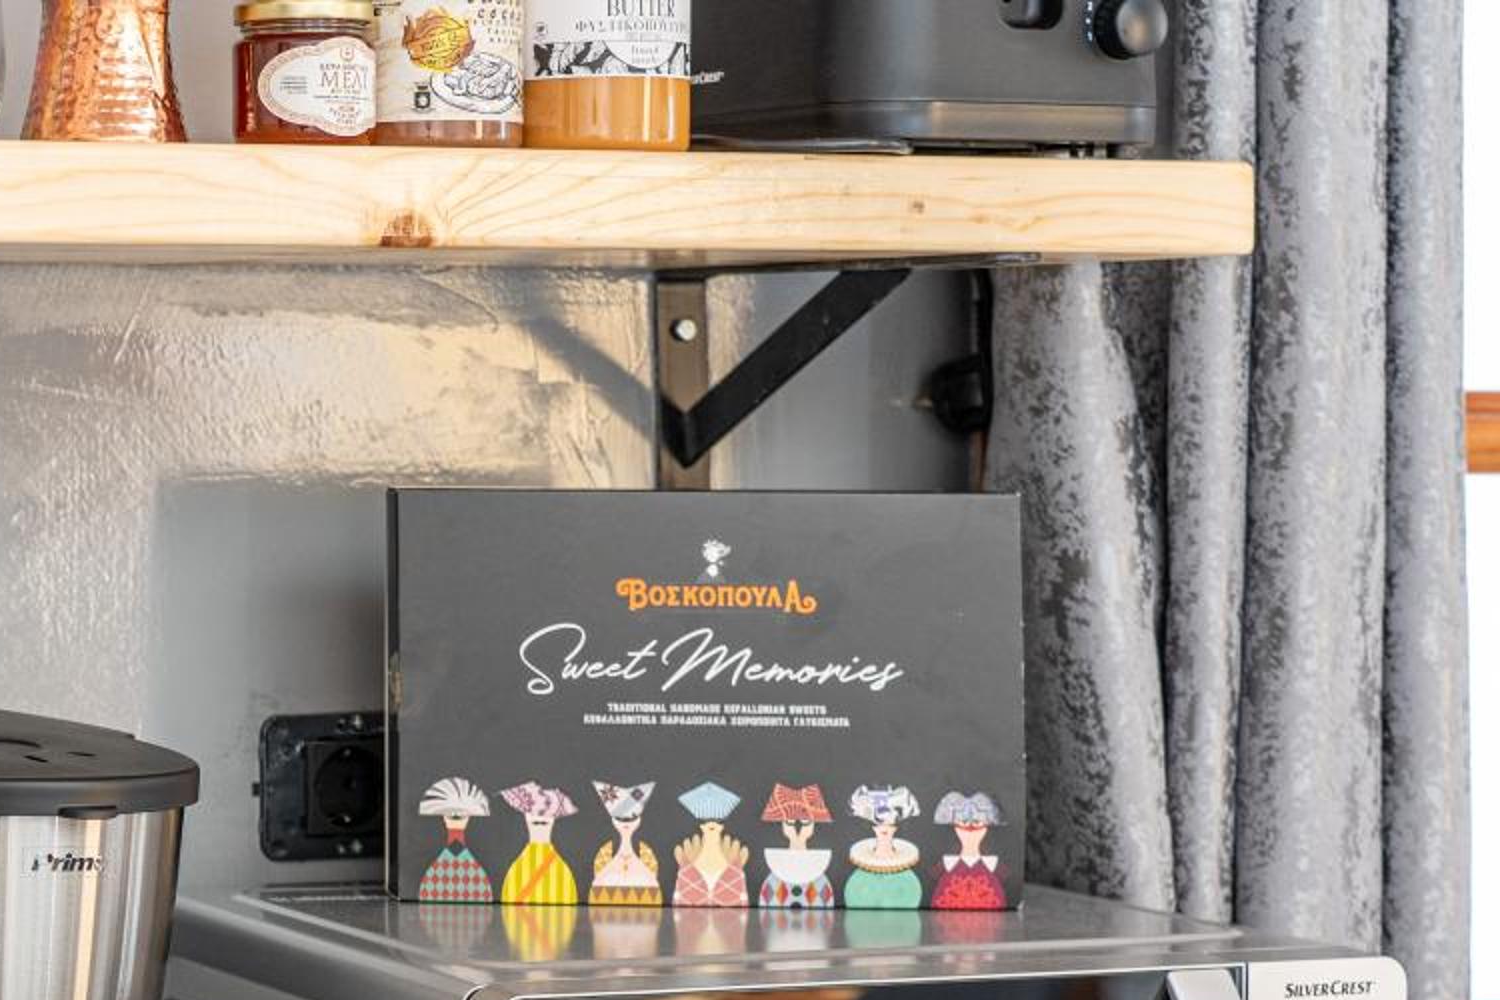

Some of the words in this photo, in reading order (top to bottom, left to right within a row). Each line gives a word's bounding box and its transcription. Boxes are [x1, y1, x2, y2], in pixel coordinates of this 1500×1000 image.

[519, 622, 658, 695] Sweet
[661, 627, 905, 692] Memories
[606, 703, 666, 713] TRADITIONAL
[669, 703, 721, 714] HANDMADE
[788, 705, 827, 716] SWEETS
